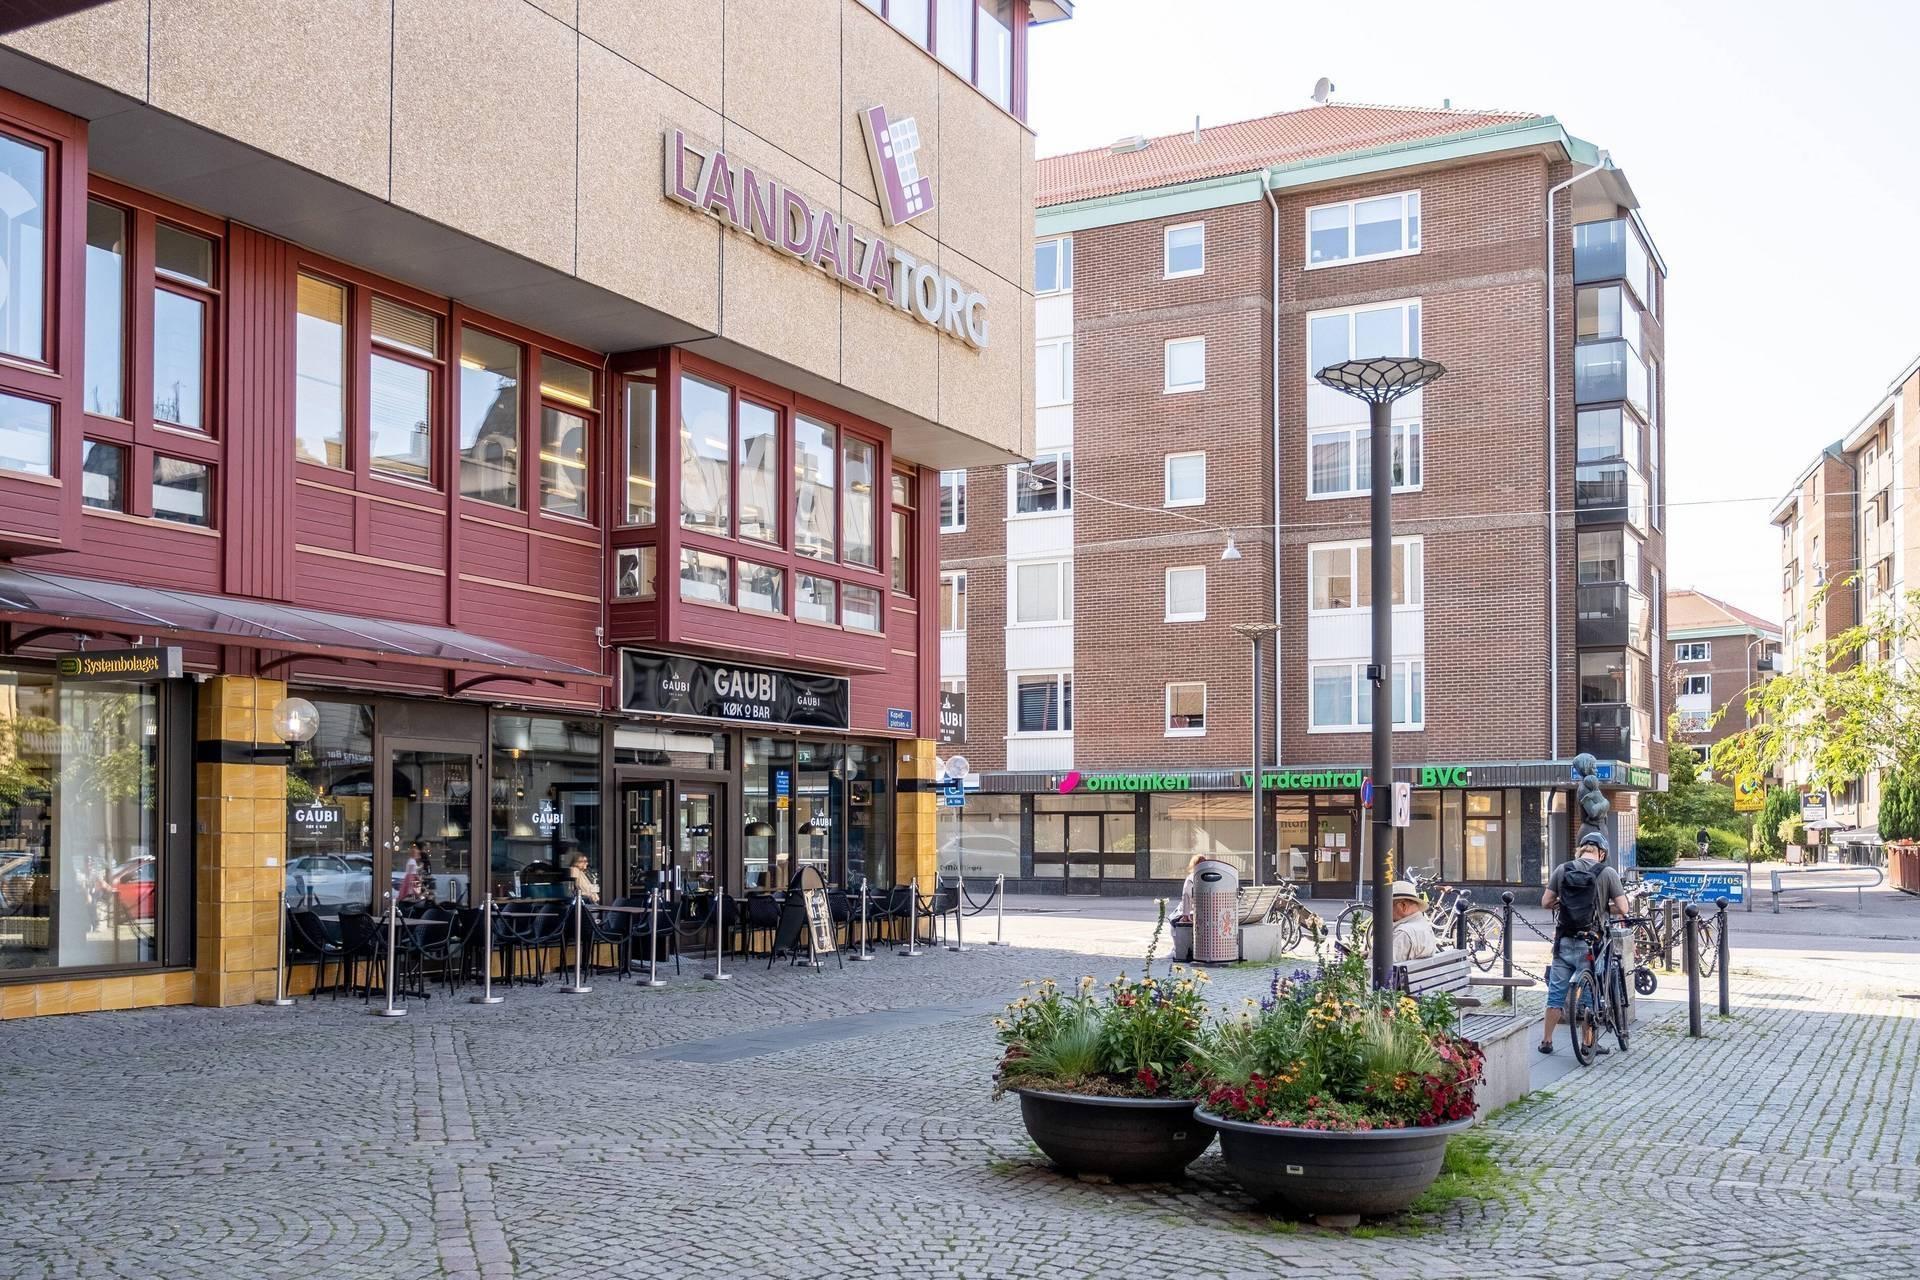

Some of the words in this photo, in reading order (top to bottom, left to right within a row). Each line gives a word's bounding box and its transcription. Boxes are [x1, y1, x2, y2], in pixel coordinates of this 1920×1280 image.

[84, 656, 159, 675] Systembolaget
[662, 679, 690, 692] GAUBI
[714, 668, 777, 702] GAUBI
[797, 695, 820, 707] GAUBI
[723, 702, 743, 716] KØK
[752, 705, 770, 719] BAR
[940, 711, 962, 727] AUBI
[1087, 772, 1190, 791] omtanken
[1422, 767, 1467, 787] BVC
[295, 809, 338, 822] GAUBI
[532, 812, 564, 824] GAUBI
[810, 817, 832, 827] GAUBI
[1669, 876, 1695, 884] LUNCH
